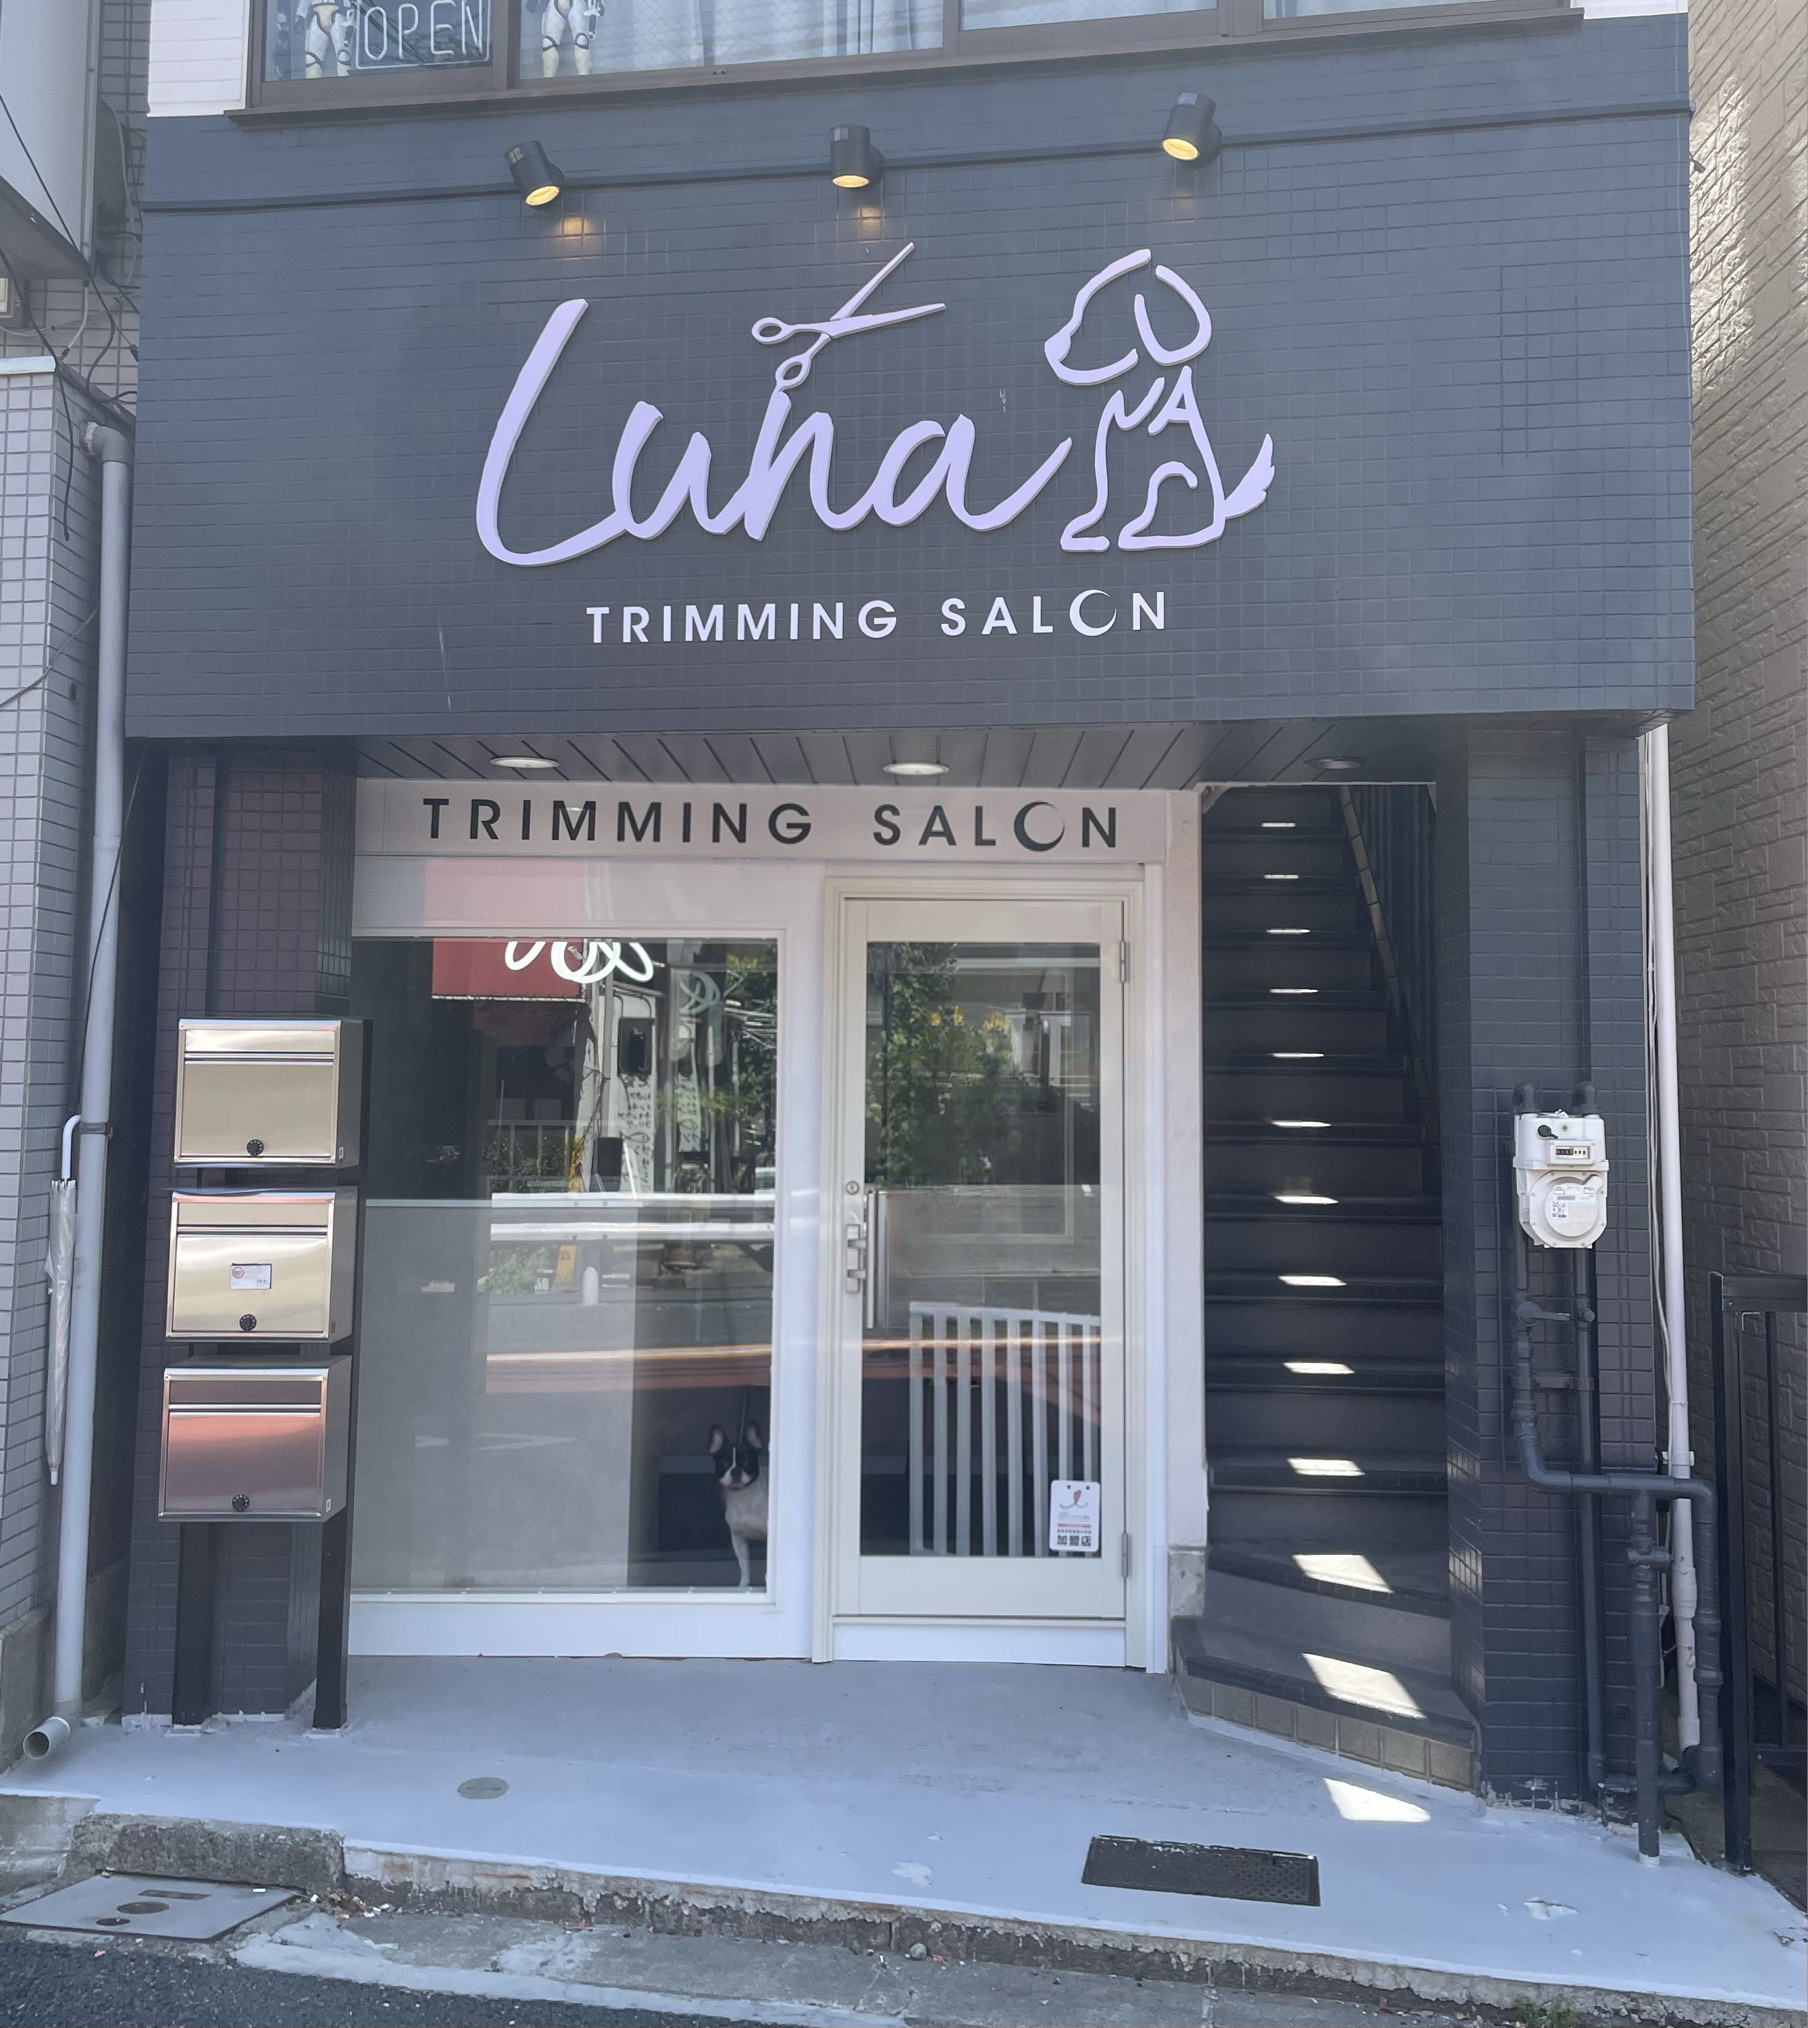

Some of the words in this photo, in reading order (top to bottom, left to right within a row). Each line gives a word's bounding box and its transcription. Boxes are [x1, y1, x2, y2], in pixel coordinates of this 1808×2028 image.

[364, 0, 483, 60] OPEN
[476, 298, 1073, 567] Luna
[586, 600, 897, 644] TRIMMING
[940, 589, 1166, 637] SALON
[422, 797, 813, 845] TRIMMING
[873, 801, 1118, 852] SALON
